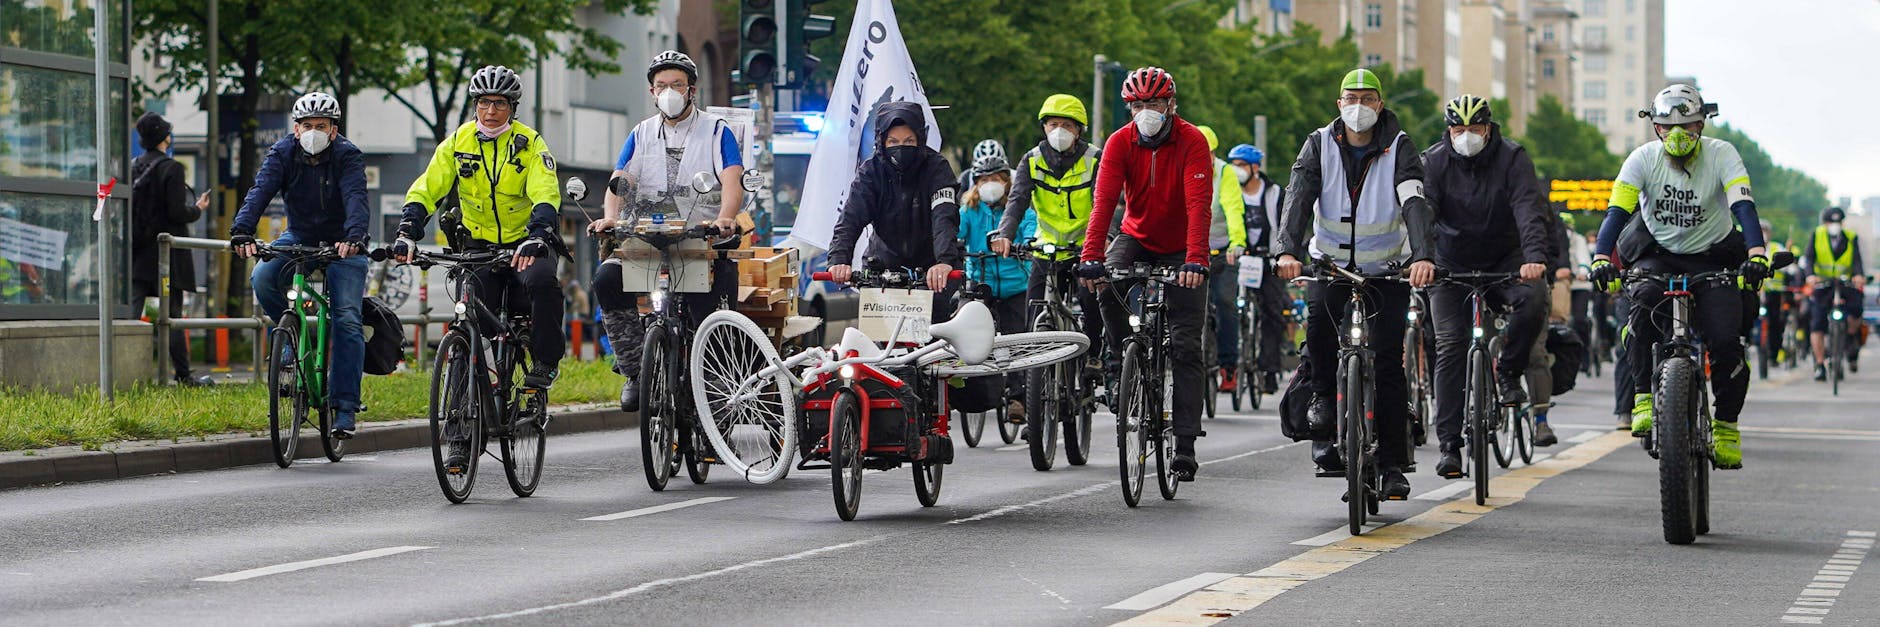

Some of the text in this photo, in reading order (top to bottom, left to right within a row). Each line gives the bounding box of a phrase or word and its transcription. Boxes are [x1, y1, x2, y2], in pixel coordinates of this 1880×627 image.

[1663, 184, 1698, 203] Stop.
[1656, 199, 1706, 216] Killing.
[1654, 210, 1708, 228] Cyclists.
[863, 303, 923, 313] #VisionZero
